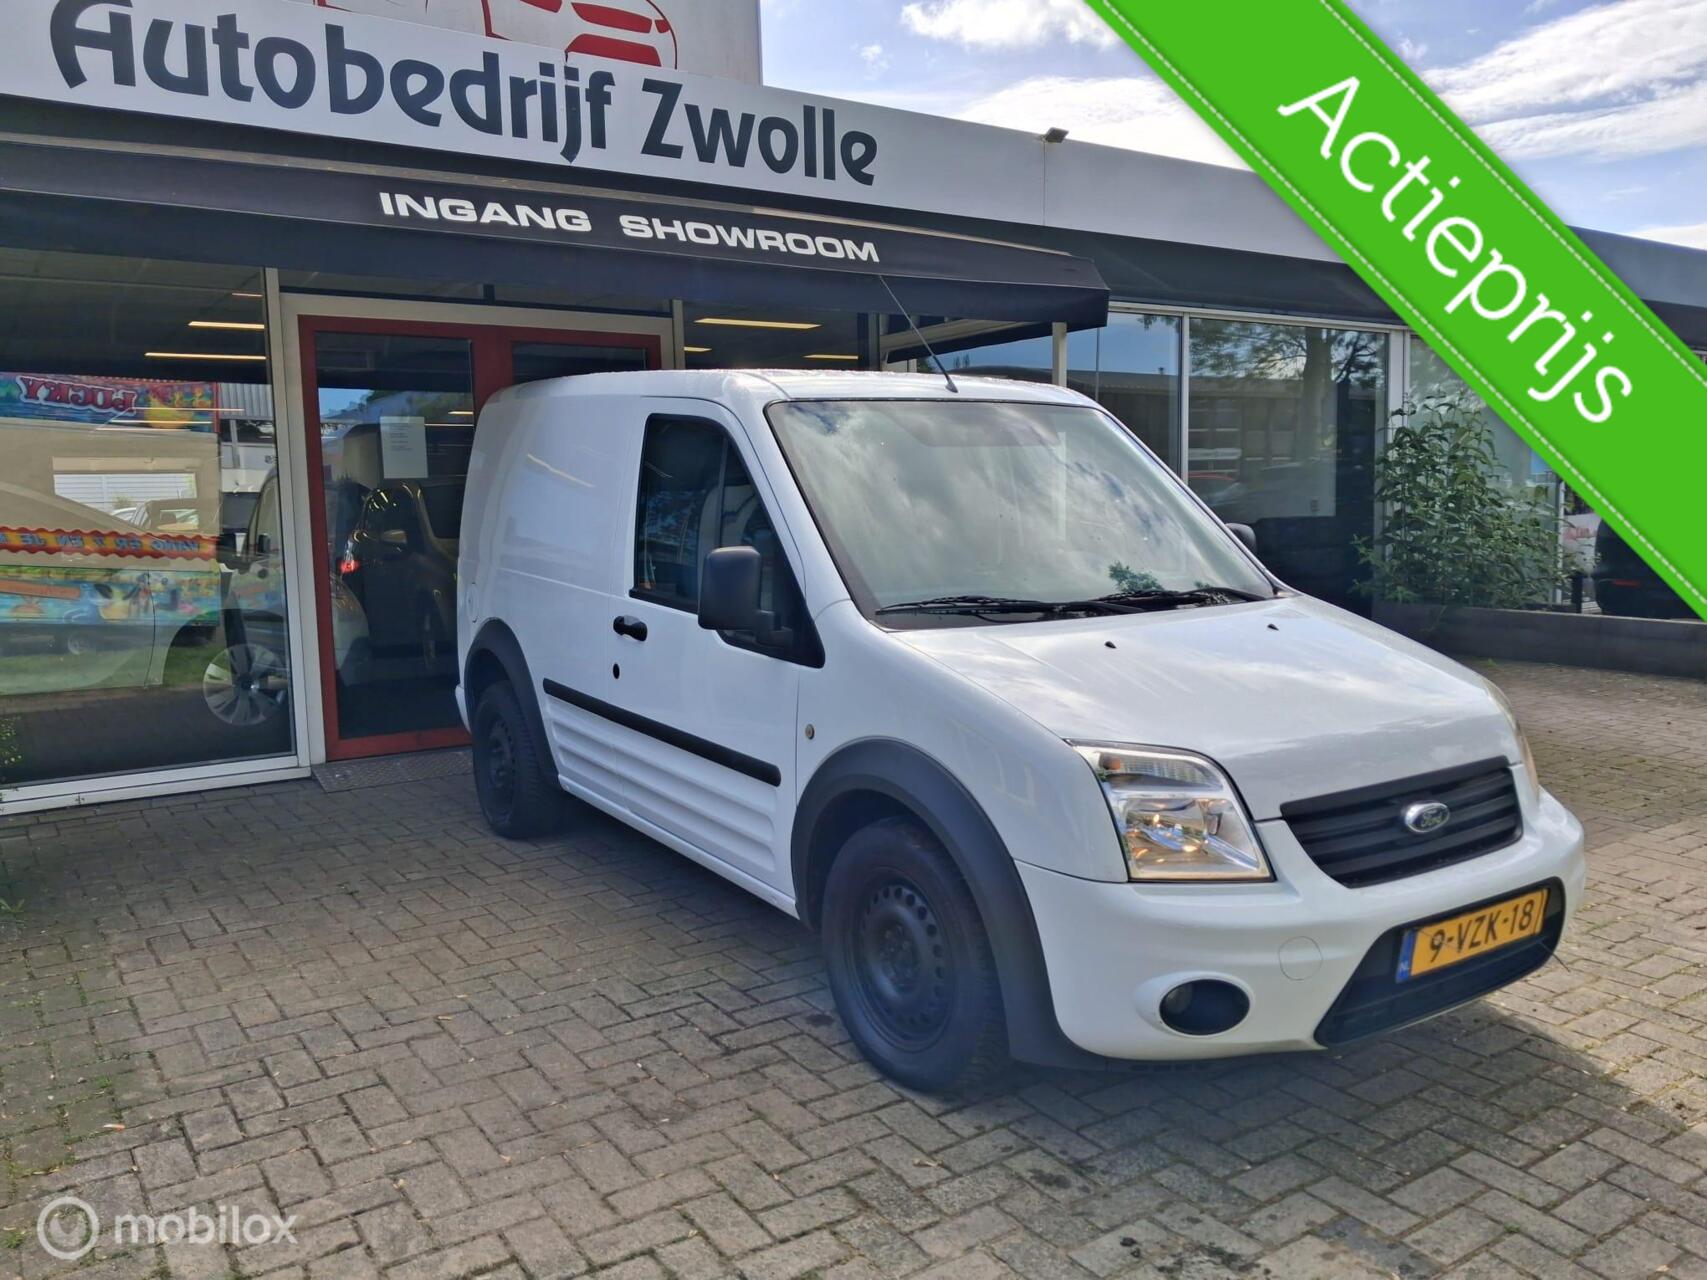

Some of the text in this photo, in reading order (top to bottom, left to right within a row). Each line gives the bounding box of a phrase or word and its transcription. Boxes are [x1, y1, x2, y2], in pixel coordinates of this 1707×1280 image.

[49, 0, 878, 186] Autobedrijf Zwolle
[379, 192, 880, 263] INGANG SHOWROOM
[1430, 899, 1535, 963] 9-VZK-18
